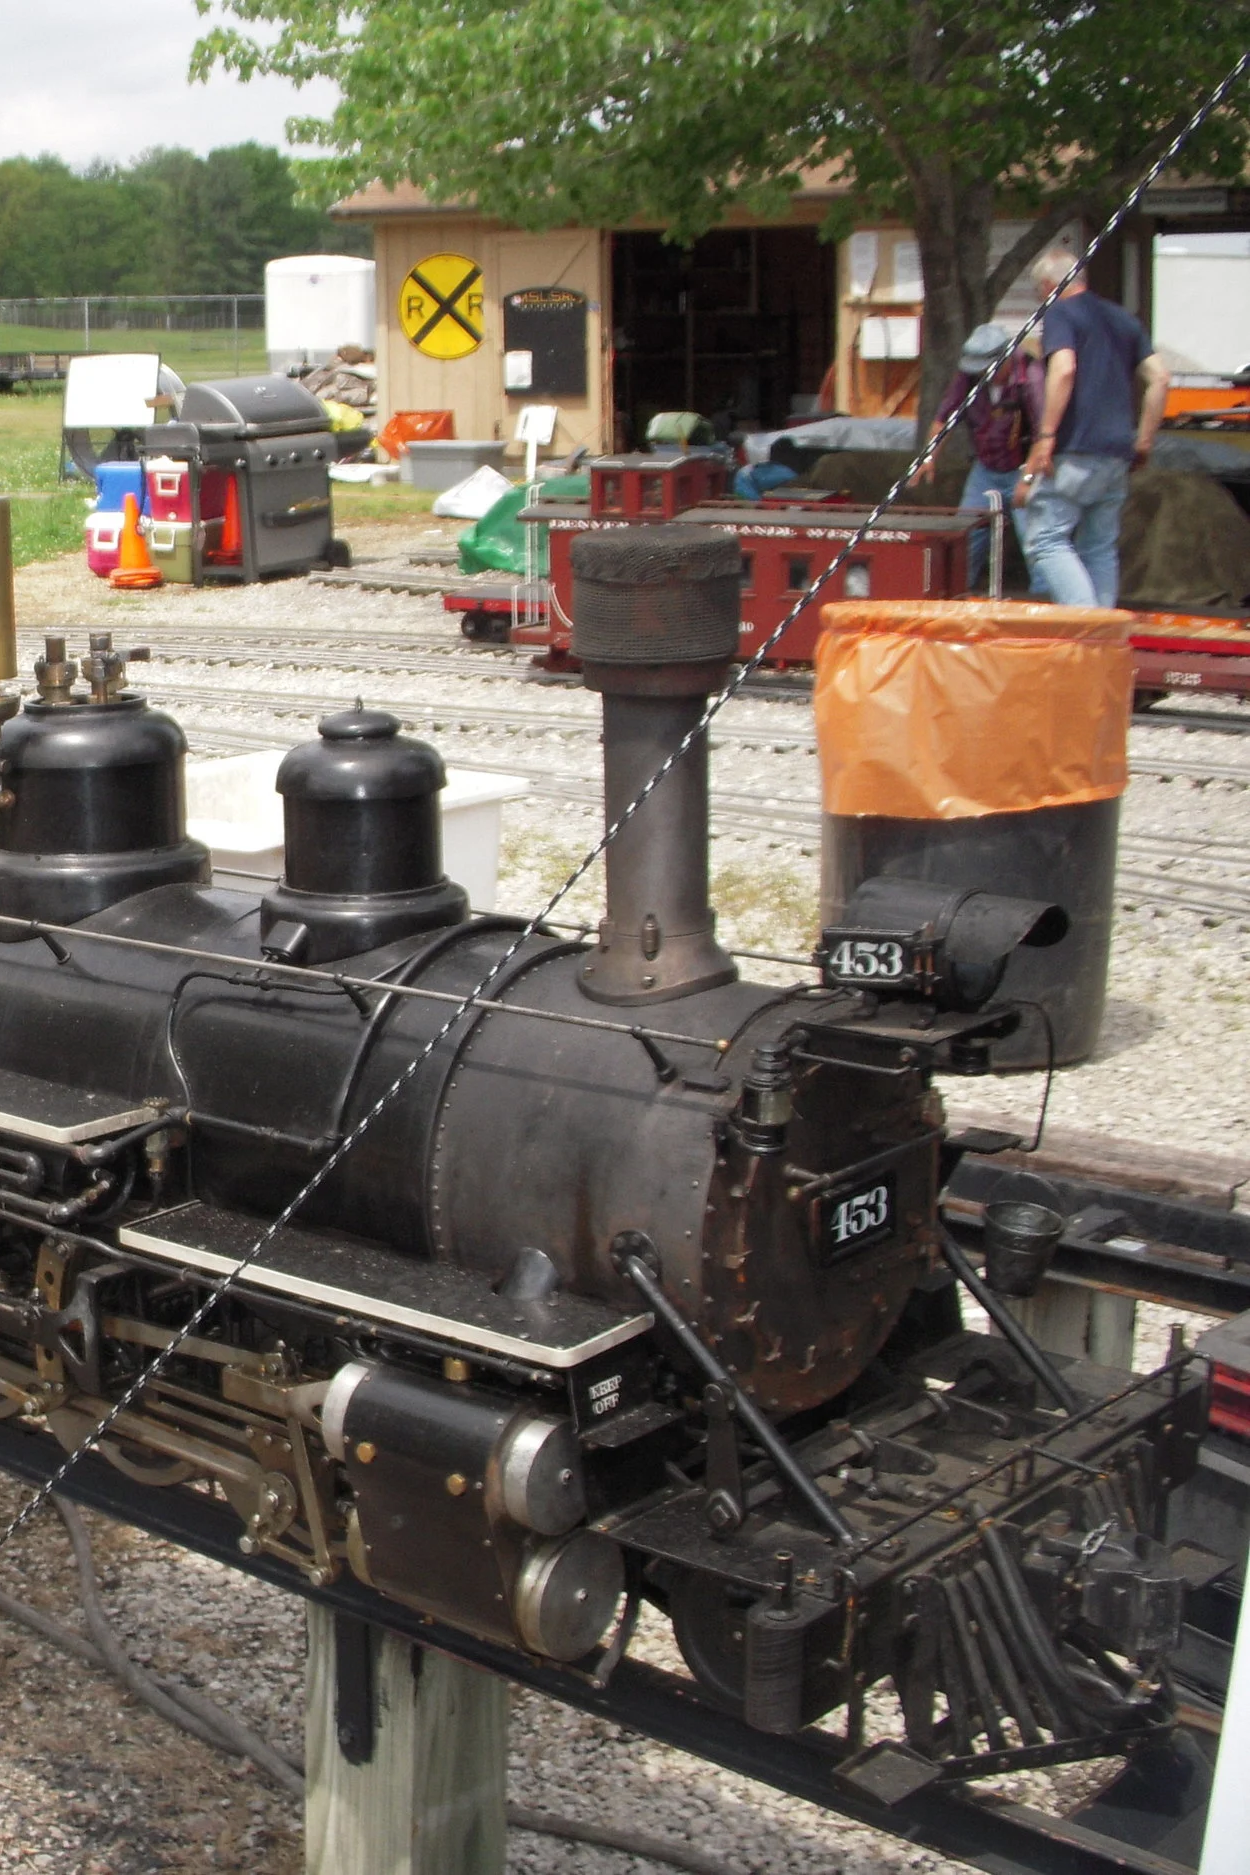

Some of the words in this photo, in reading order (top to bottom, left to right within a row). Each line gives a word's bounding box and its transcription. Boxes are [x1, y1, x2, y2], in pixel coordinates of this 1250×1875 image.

[407, 295, 424, 319] R
[548, 519, 630, 531] DENVER
[805, 527, 912, 542] WESERN
[830, 940, 904, 977] 453
[830, 1186, 888, 1243] 453
[589, 1374, 623, 1400] KEEP
[592, 1392, 620, 1415] OFF
